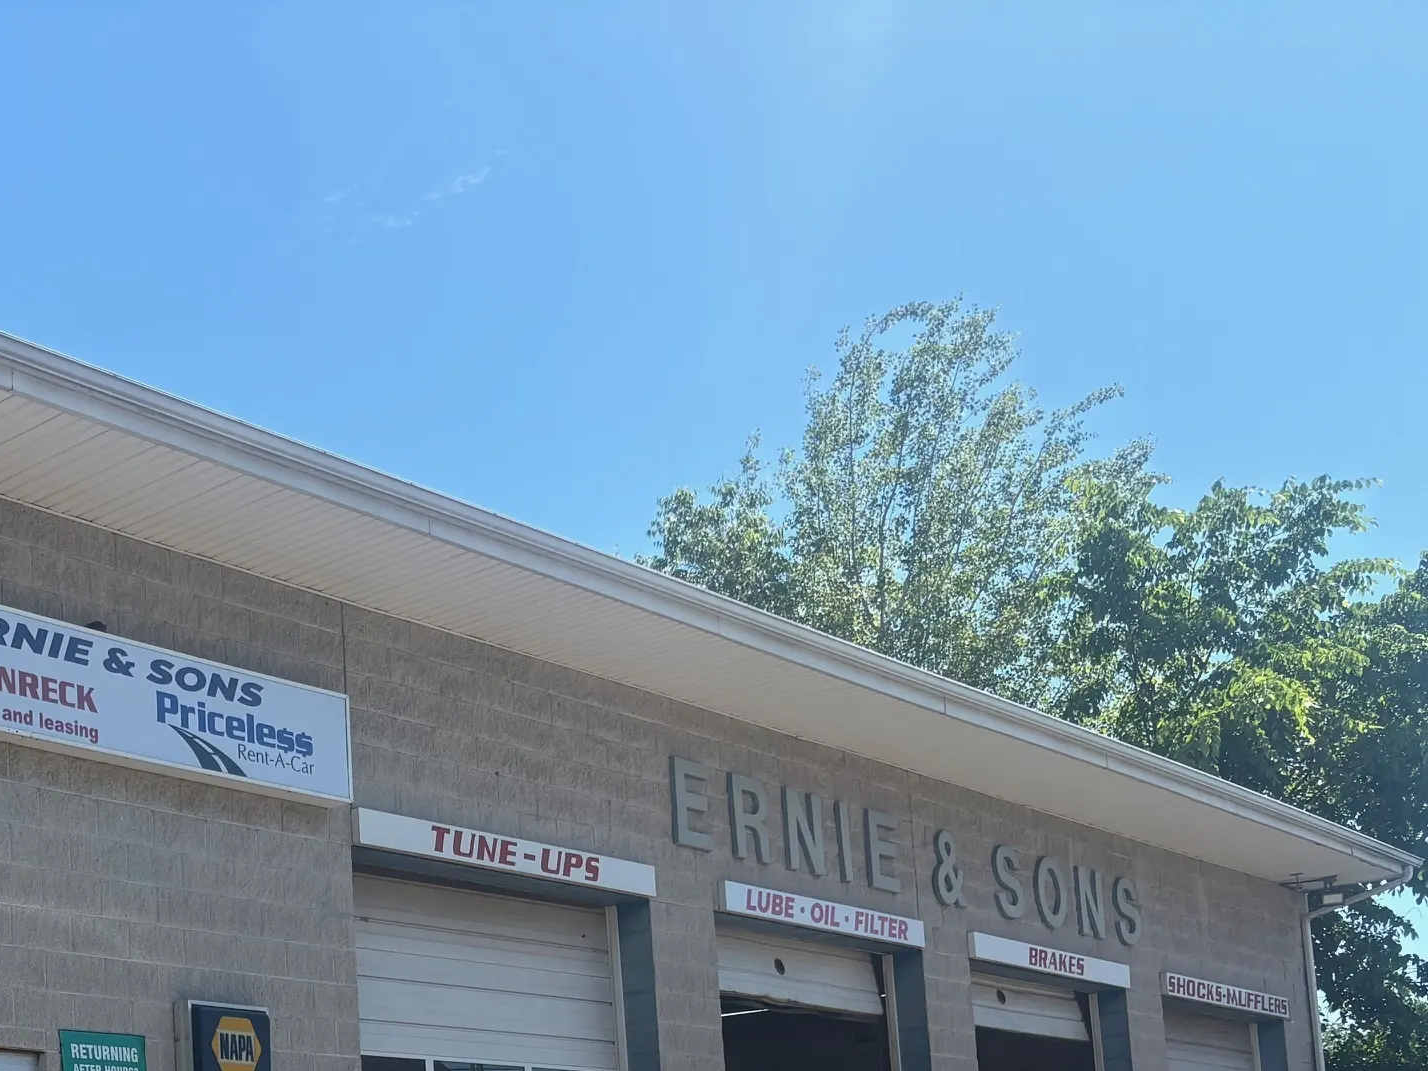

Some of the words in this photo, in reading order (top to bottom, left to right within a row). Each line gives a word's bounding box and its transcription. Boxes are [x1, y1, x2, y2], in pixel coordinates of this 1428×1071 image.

[102, 647, 136, 678] &
[146, 658, 264, 708] SONS
[2, 704, 34, 726] and
[39, 712, 99, 744] leasing
[238, 743, 315, 775] Rent-A-Car
[431, 825, 600, 883] TUNE-UPS
[670, 756, 902, 894] ERNIE
[933, 830, 965, 907] &
[991, 844, 1143, 946] SONS
[746, 888, 795, 919] LUBE
[810, 902, 840, 928] OIL
[854, 910, 909, 941] FILTER
[1028, 946, 1085, 977] BRAKES
[70, 1043, 139, 1063] RETURNING
[219, 1032, 254, 1063] NAPA
